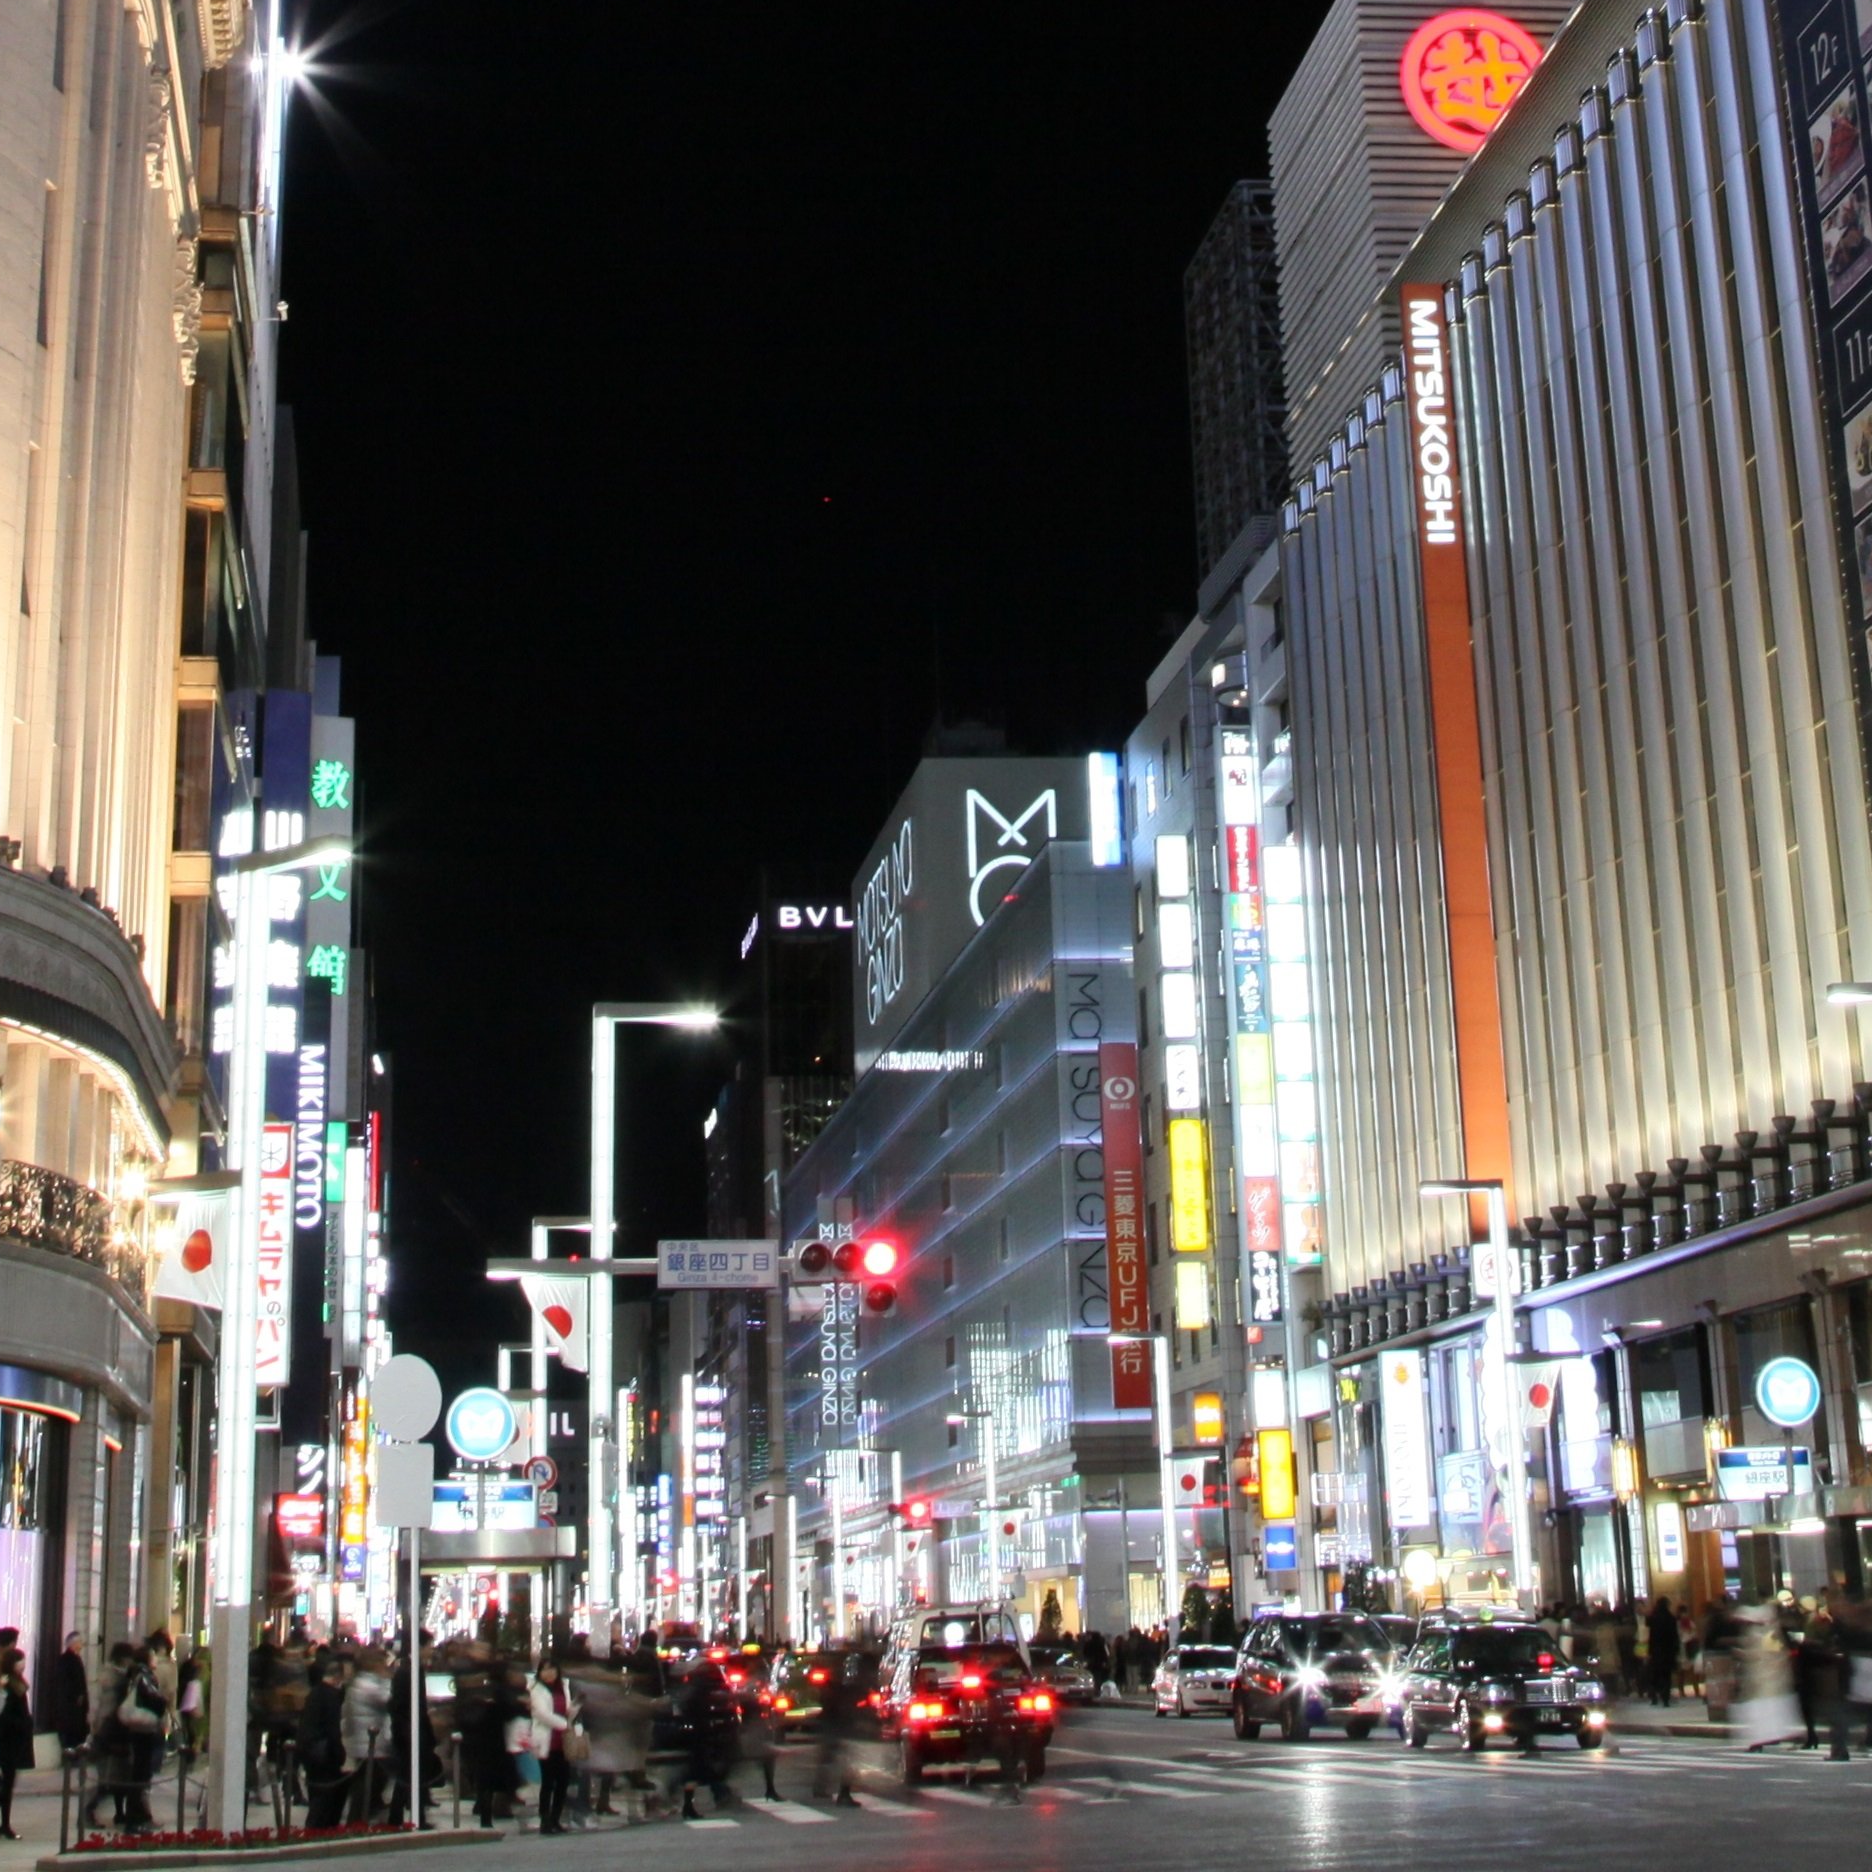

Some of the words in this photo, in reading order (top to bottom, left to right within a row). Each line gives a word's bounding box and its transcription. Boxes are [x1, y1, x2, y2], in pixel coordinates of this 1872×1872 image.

[1408, 299, 1456, 544] MITSUKOSHI
[296, 1044, 326, 1229] MIKIMOTO
[667, 1252, 770, 1272] 銀座四丁目
[677, 1273, 708, 1284] Ginza
